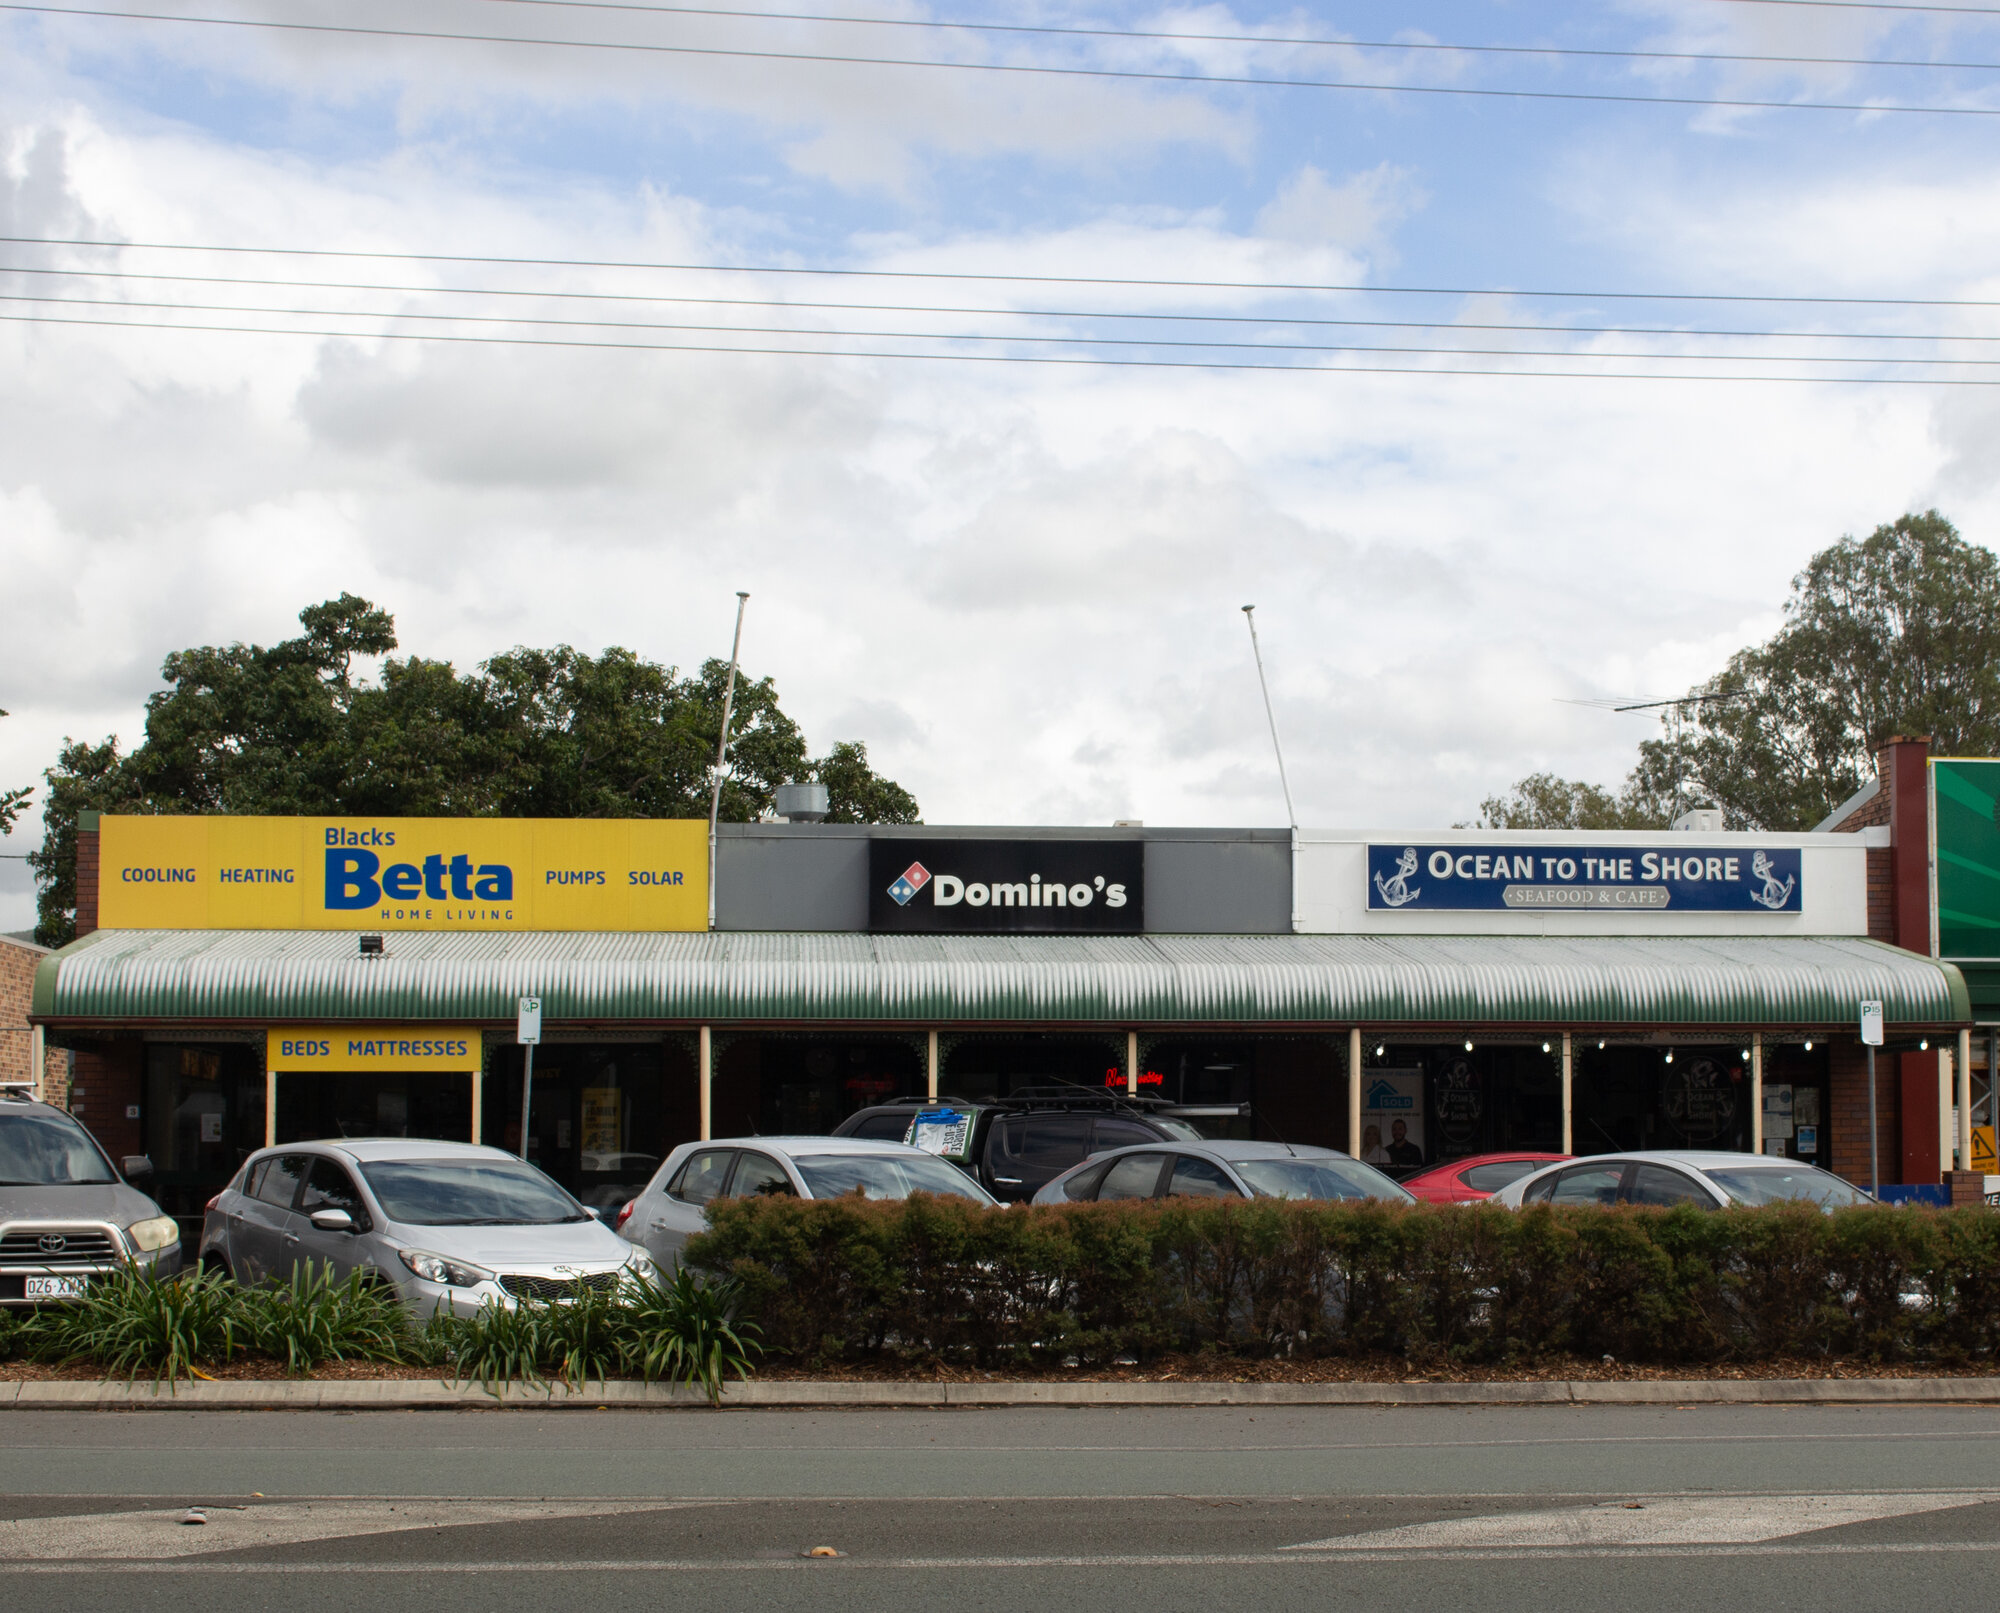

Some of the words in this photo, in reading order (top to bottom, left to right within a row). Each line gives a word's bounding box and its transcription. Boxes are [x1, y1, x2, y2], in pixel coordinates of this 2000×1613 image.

[325, 827, 396, 846] Blacks
[1427, 850, 1535, 881] OCEAN
[1541, 857, 1578, 881] TO
[1581, 858, 1633, 881] THE
[1640, 851, 1741, 882] SHORE
[122, 867, 196, 883] COOLING
[220, 868, 294, 884] HEATING
[324, 848, 513, 910] Betta
[545, 869, 606, 886] PUMPS
[628, 870, 684, 886] SOLAR
[933, 873, 1128, 908] Domino's
[1515, 889, 1594, 904] SEAFOOD
[1598, 889, 1612, 904] &
[1616, 889, 1658, 904] CAFE
[381, 909, 434, 920] HOME
[446, 909, 514, 921] LIVING
[281, 1040, 331, 1056] BEDS
[348, 1040, 468, 1056] MATTRESSES
[1383, 1098, 1412, 1107] SOLD
